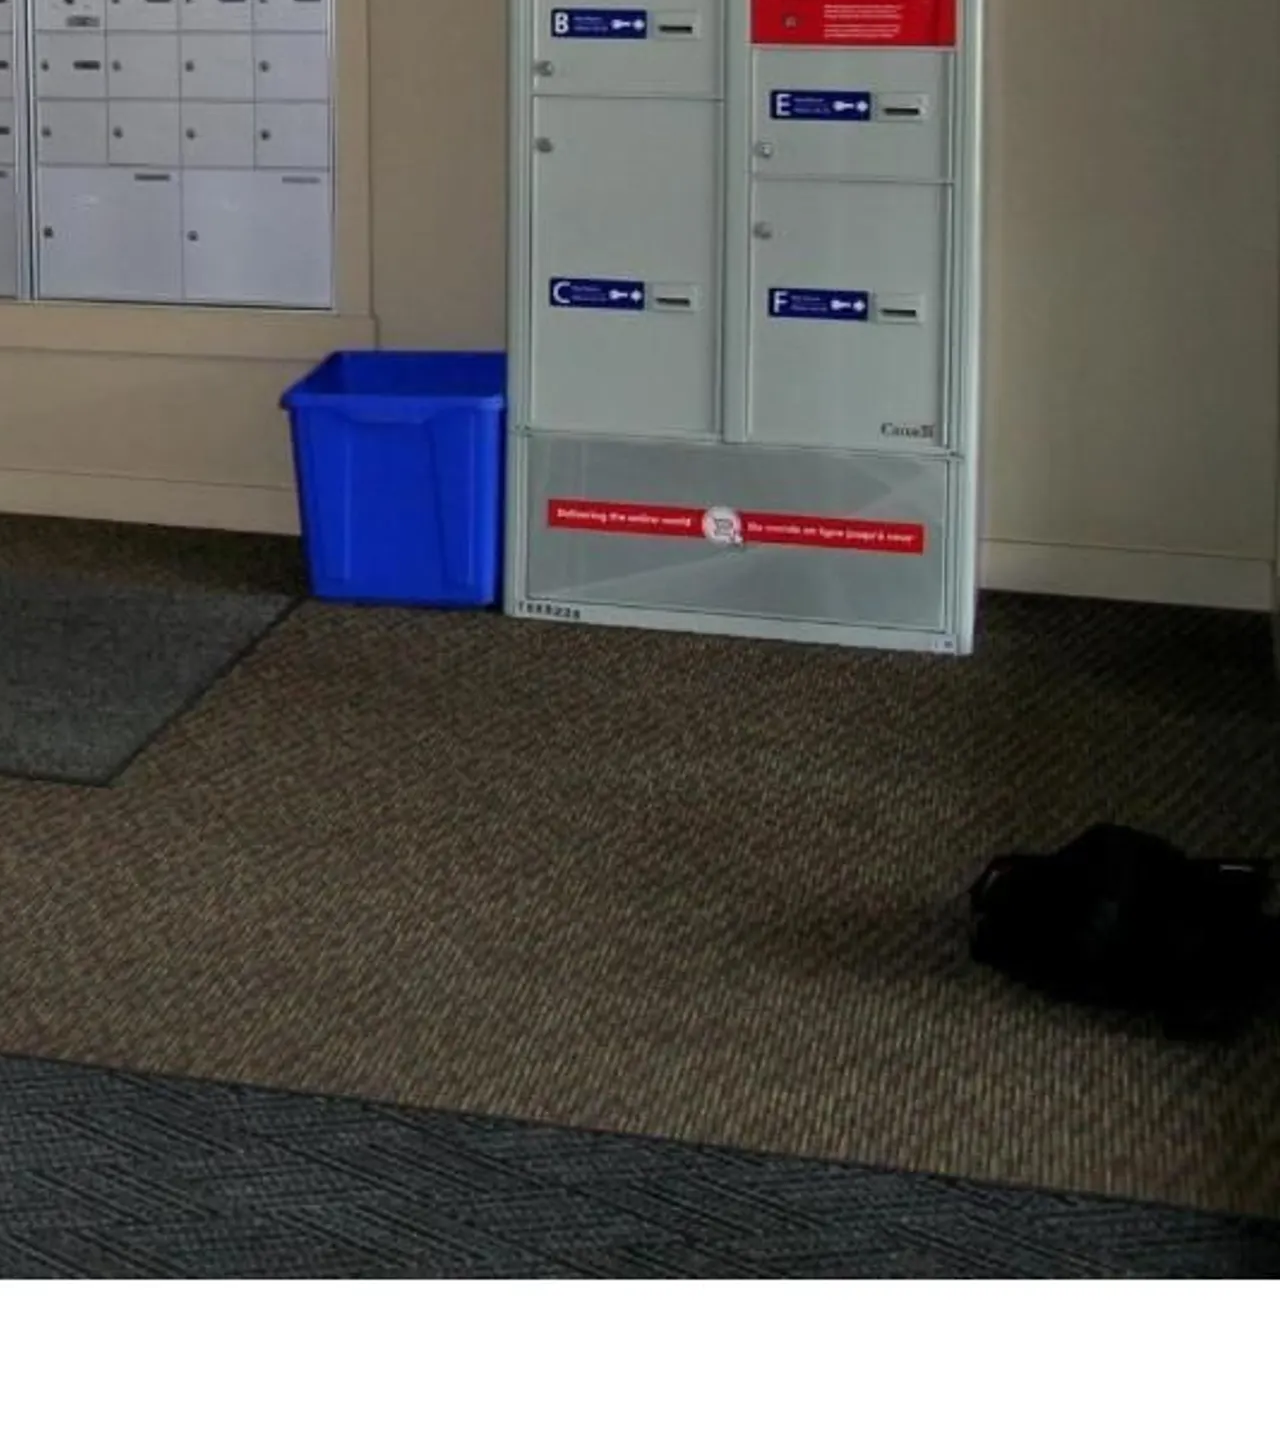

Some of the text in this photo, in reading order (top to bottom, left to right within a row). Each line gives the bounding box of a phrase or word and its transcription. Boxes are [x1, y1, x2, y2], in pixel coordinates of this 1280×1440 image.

[555, 12, 569, 34] B
[776, 93, 791, 116] E
[553, 280, 571, 304] C
[773, 290, 788, 313] F
